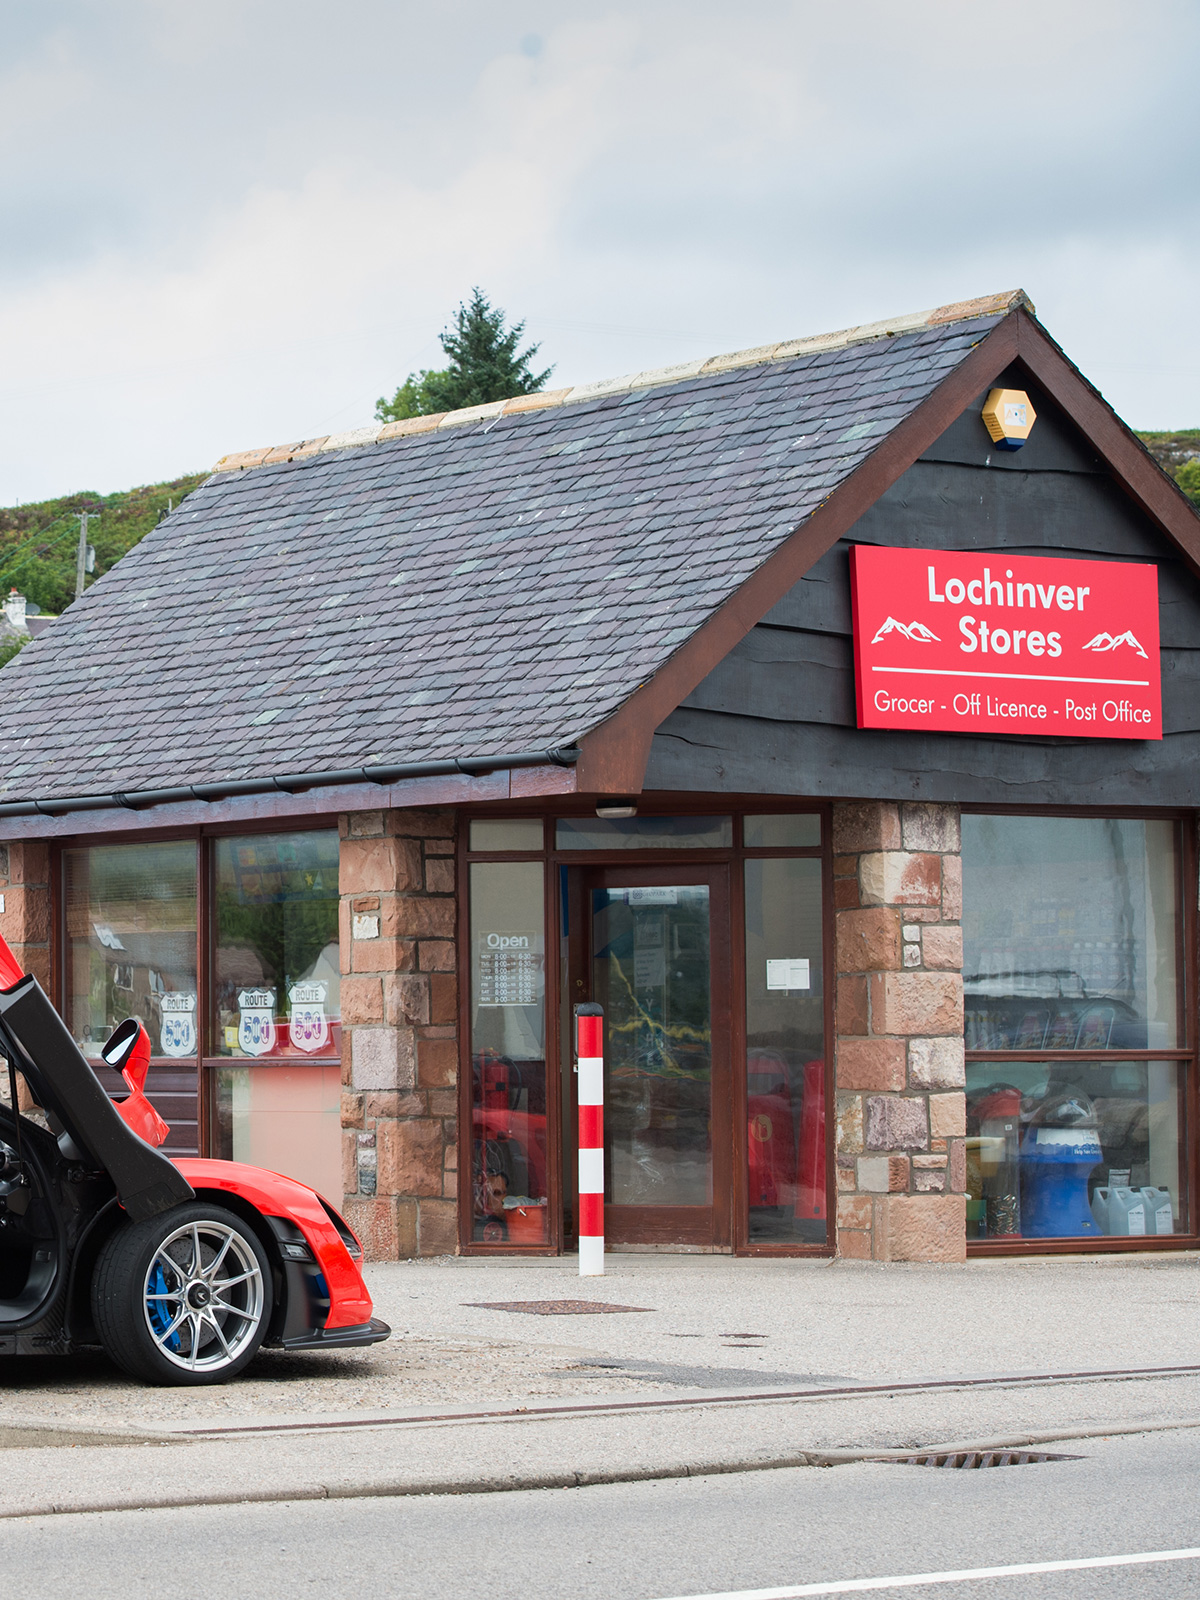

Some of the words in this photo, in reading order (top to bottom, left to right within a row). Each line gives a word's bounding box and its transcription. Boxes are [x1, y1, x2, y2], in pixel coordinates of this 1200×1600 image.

[928, 566, 1090, 611] Lochinver
[959, 615, 1062, 658] Stores
[874, 690, 935, 714] Grocer
[953, 694, 981, 715] Off
[987, 695, 1047, 719] Licence
[1065, 699, 1097, 721] Post
[1102, 700, 1152, 724] Office
[487, 933, 529, 950] Open
[167, 999, 189, 1010] ROUTE
[245, 994, 268, 1006] ROUTE
[295, 989, 319, 1001] ROUTE
[166, 1020, 190, 1047] 500
[244, 1016, 270, 1044] 500
[295, 1011, 322, 1040] 500
